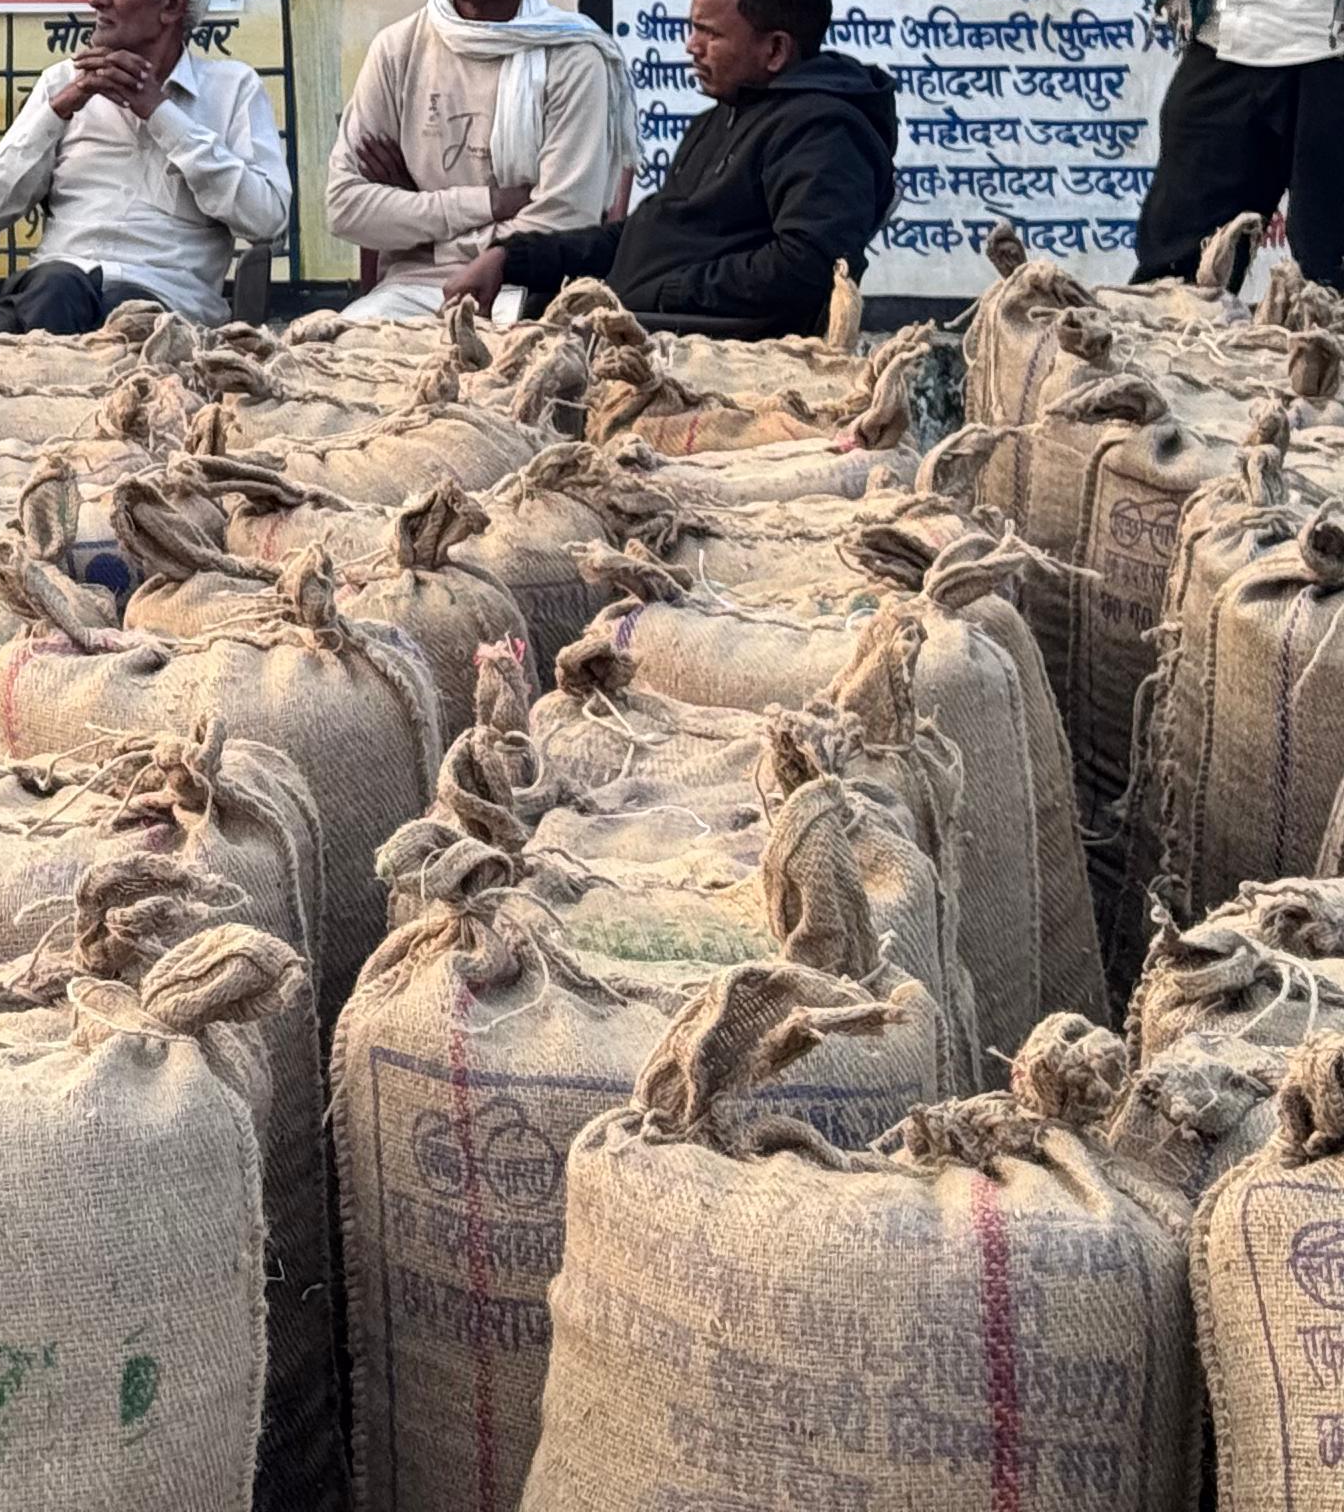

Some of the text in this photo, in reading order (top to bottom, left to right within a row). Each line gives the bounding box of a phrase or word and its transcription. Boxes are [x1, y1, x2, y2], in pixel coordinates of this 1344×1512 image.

[637, 3, 691, 44] श्रीमा
[901, 6, 1037, 53] अधिकारी
[1012, 64, 1130, 111] उदयपुर
[907, 108, 1146, 160] महोदय उदयपुर
[948, 152, 1156, 209] महोदय उदयप
